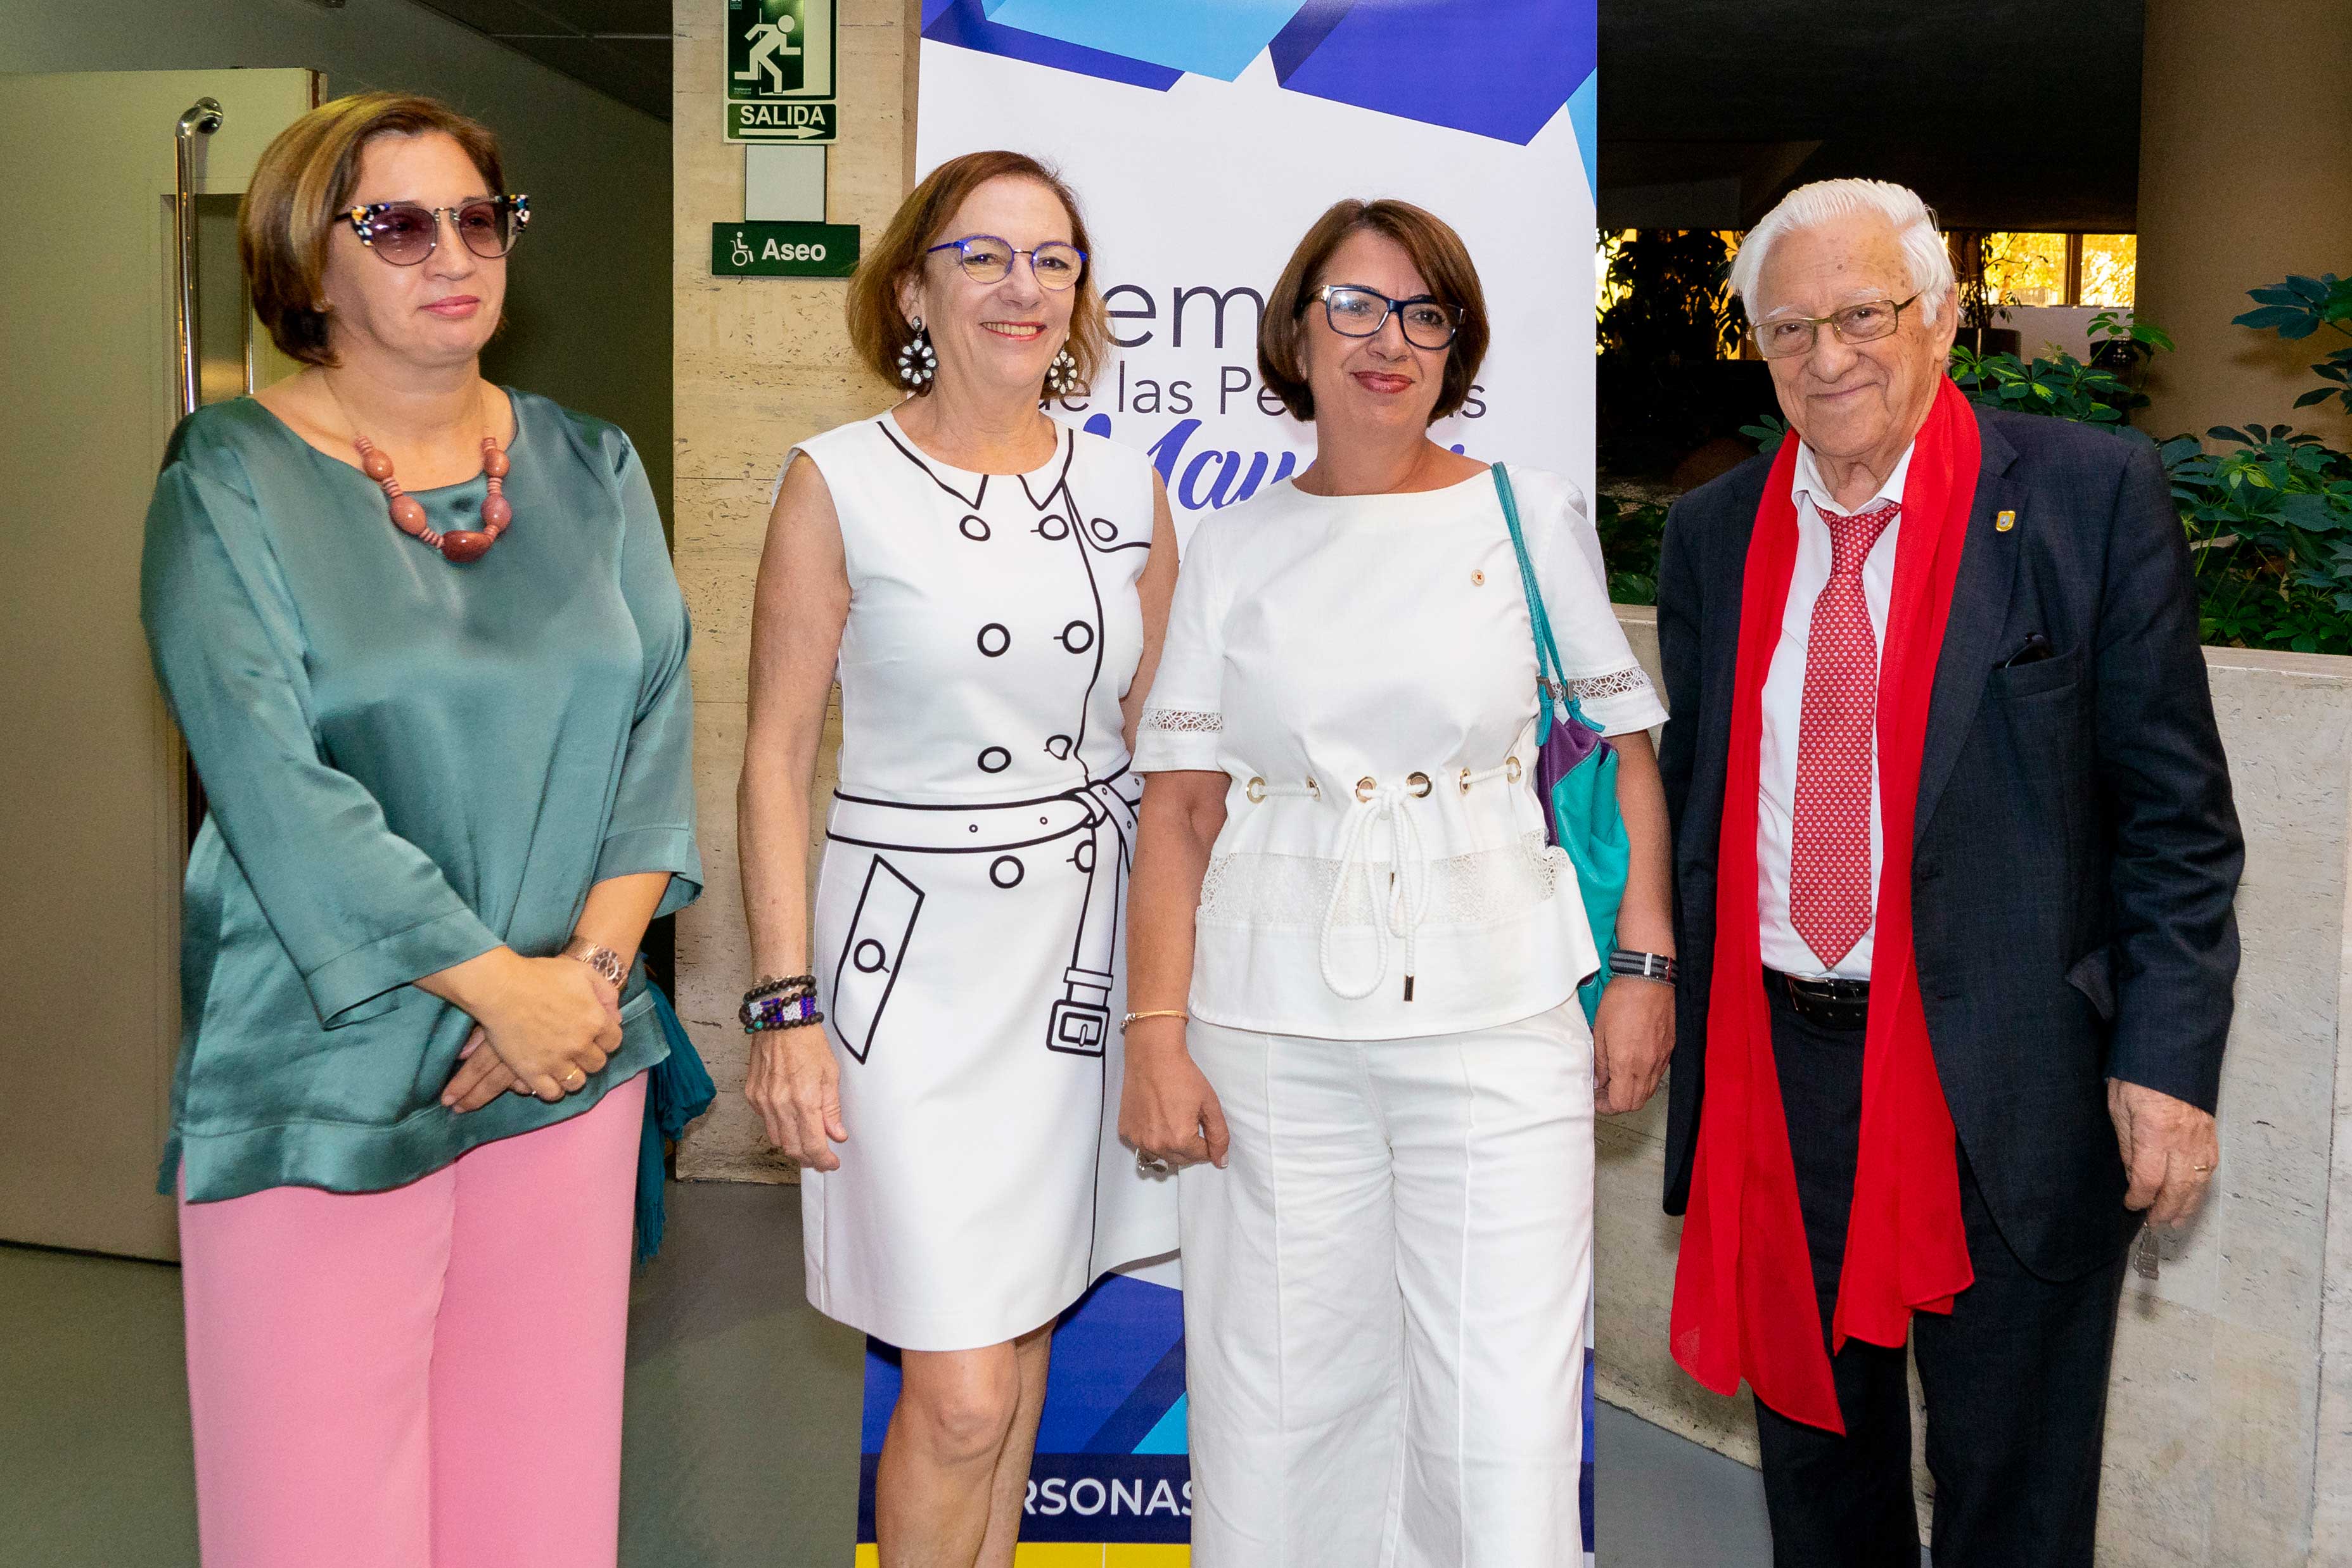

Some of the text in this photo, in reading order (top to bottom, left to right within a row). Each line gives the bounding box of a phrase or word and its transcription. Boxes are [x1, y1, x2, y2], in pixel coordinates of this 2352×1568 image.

[740, 105, 826, 125] SALIDA
[762, 238, 826, 261] Aseo
[1118, 360, 1193, 414] las
